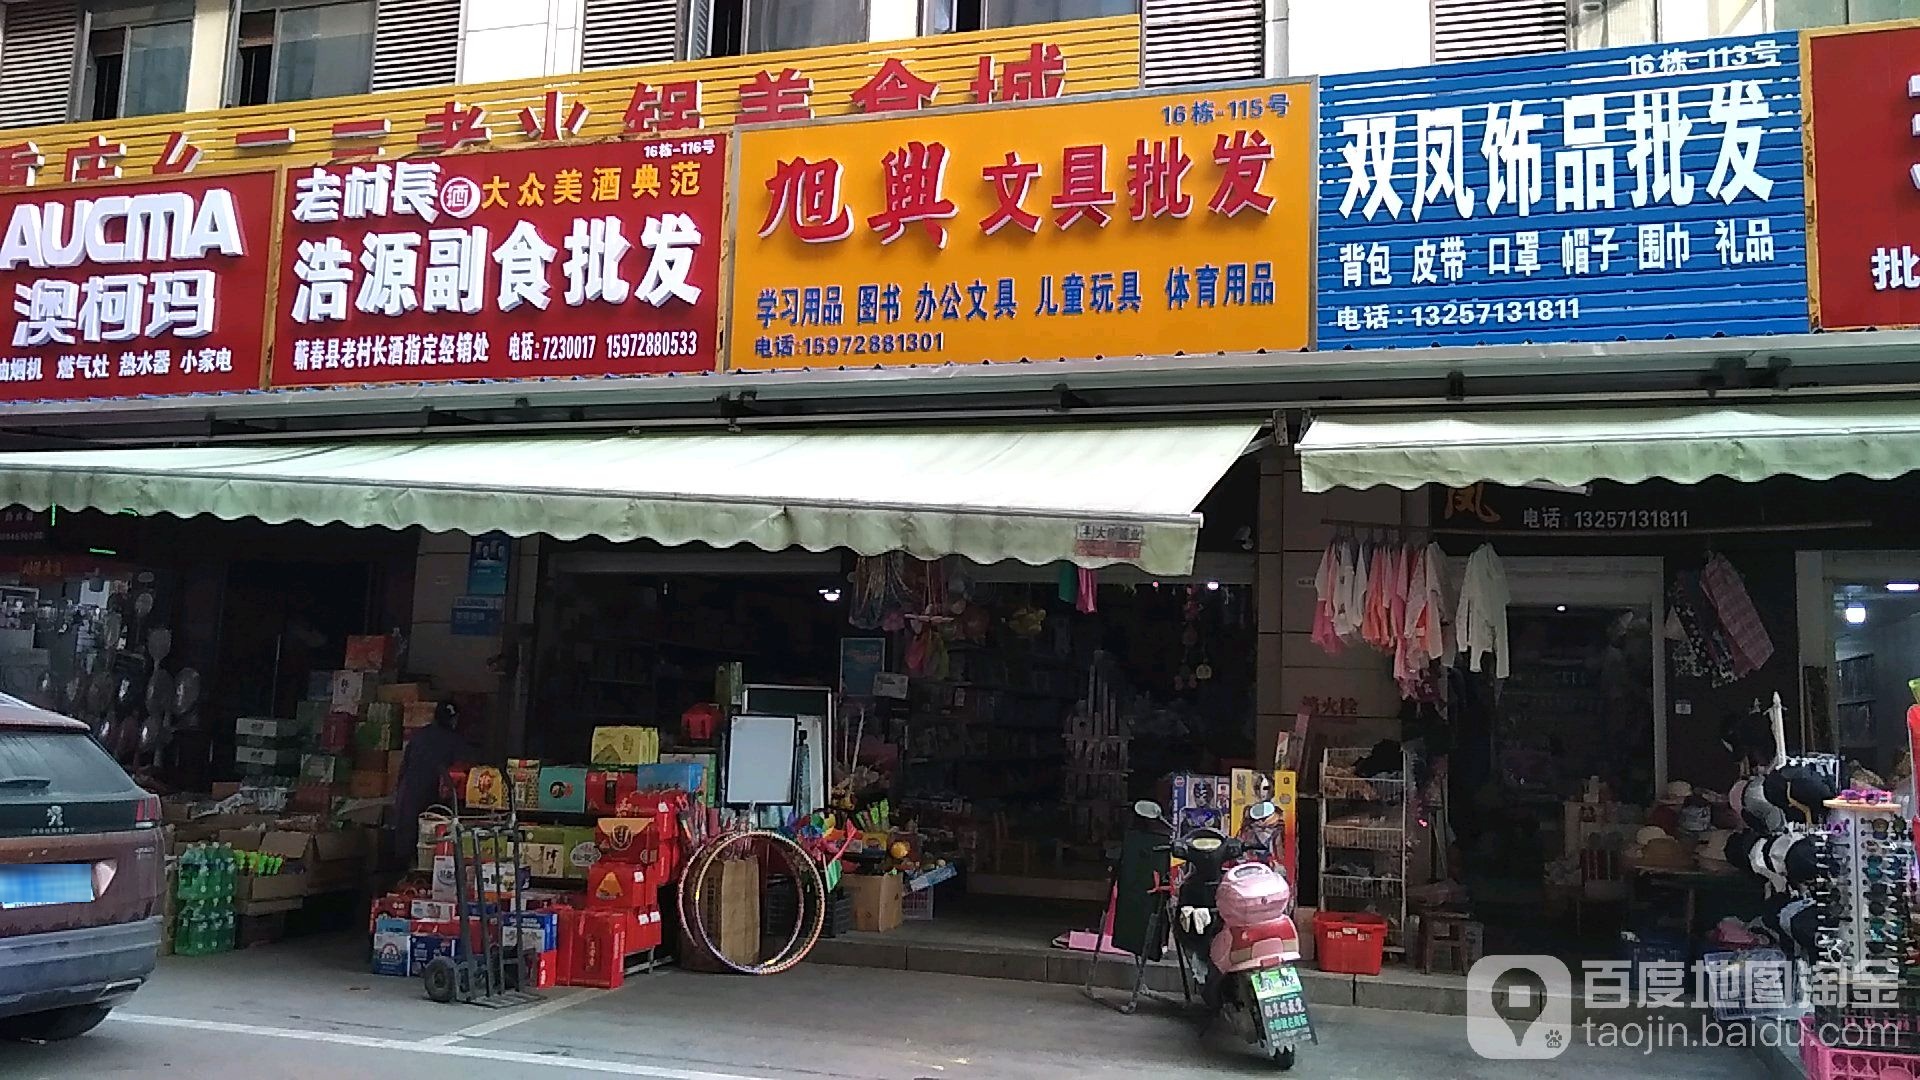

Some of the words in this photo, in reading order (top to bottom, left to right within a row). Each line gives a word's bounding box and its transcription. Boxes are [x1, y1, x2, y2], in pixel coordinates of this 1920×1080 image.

[1628, 40, 1782, 76] 16栋-113号
[1162, 93, 1290, 125] 16栋-115号
[643, 139, 716, 159] 16栋-116号
[1338, 79, 1775, 222] 双凤饰品批发
[481, 160, 700, 210] 大众美酒典范
[757, 129, 1275, 251] 旭興文具批发
[0, 188, 243, 270] AUCMA
[1339, 243, 1392, 287] 背包
[1411, 236, 1467, 284] 皮带
[1488, 231, 1541, 276] 口罩
[1561, 228, 1619, 275] 帽子
[1638, 222, 1690, 270] 围巾
[1714, 218, 1775, 264] 礼品
[291, 212, 702, 324] 浩源副食批发
[757, 286, 843, 328] 学习用品
[857, 285, 901, 324] 图书
[915, 277, 1017, 321] 办公文具
[1035, 270, 1142, 316] 儿童玩具
[1165, 262, 1275, 307] 体育用品
[11, 269, 215, 346] 澳柯玛
[56, 353, 110, 379] 燃气灶
[118, 349, 171, 376] 热水器
[179, 347, 233, 374] 小家电
[293, 331, 490, 371] 蕲春县老村长酒指定经销处
[607, 332, 698, 359] 15972880533
